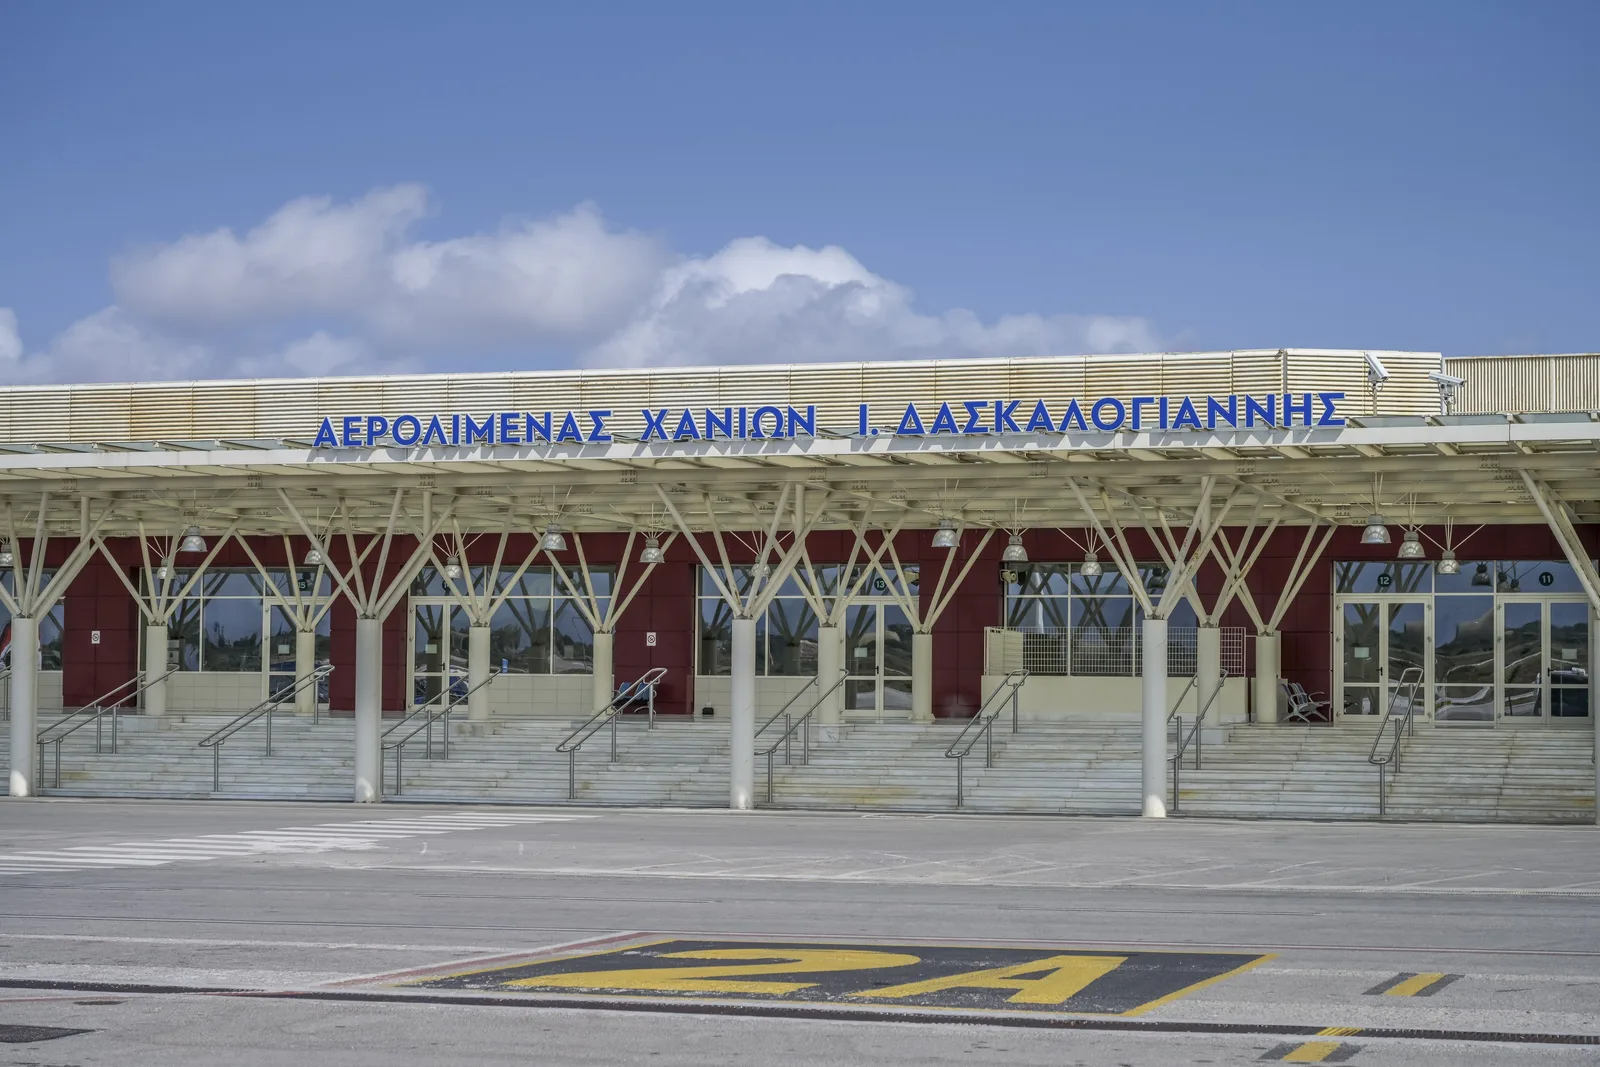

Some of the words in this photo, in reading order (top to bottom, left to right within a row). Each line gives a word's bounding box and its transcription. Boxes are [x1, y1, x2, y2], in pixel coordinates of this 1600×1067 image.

[313, 410, 613, 447] ΑΕΡΟΛΙΜΕΝΑΣ
[640, 405, 816, 441] ΧΑΝΙΩΝ
[895, 392, 1346, 436] ΔΑΣΚΑΛΟΓΙΑΝΝΗΣ
[1379, 576, 1390, 585] 12
[1541, 575, 1551, 583] 11
[875, 580, 885, 588] 13
[500, 948, 1128, 1004] 2A
